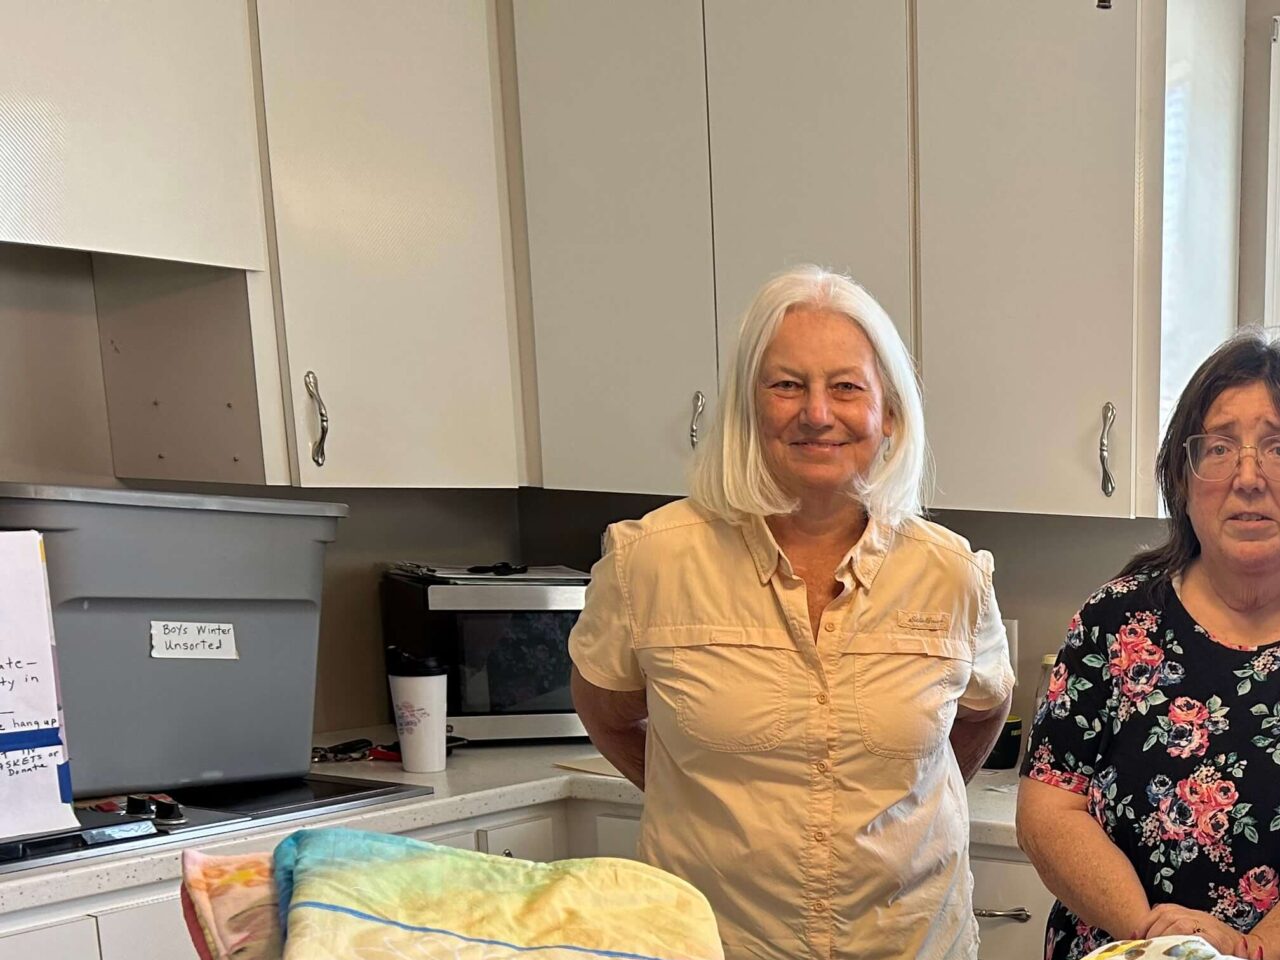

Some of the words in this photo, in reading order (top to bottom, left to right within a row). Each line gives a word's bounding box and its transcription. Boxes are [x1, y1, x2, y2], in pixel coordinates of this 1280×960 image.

[196, 625, 231, 636] Winter
[165, 639, 222, 651] Unsorted
[25, 674, 39, 683] in
[12, 718, 40, 730] hang
[43, 718, 57, 727] up
[8, 763, 48, 777] Donate
